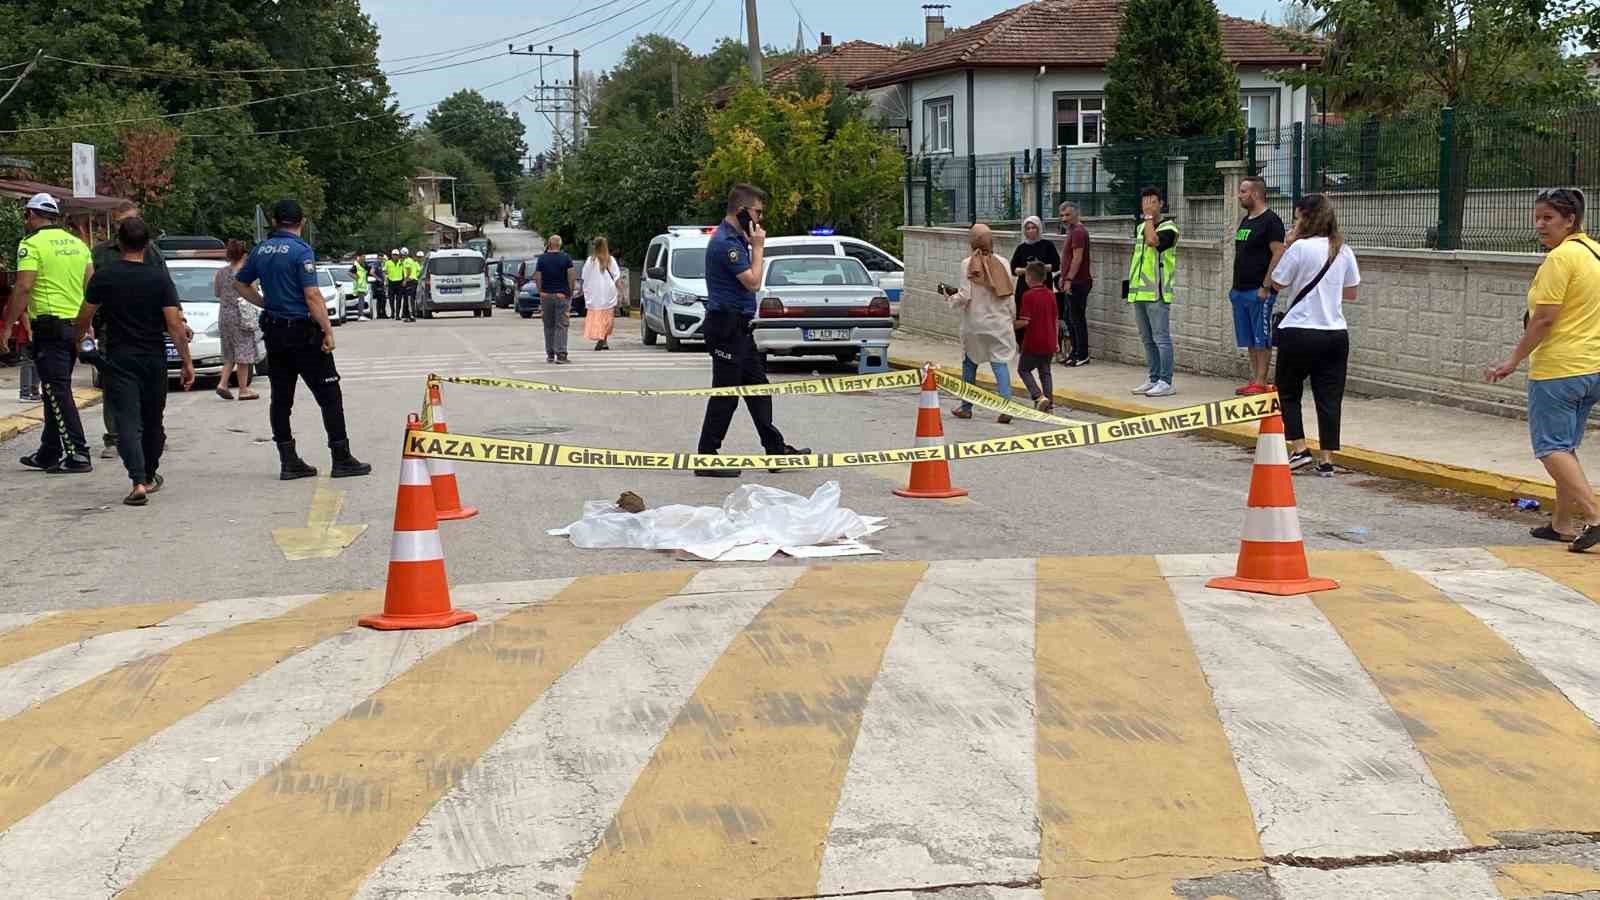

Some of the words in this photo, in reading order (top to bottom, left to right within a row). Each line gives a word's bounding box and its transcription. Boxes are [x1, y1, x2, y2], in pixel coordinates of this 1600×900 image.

[410, 436, 475, 458] KAZA
[480, 443, 533, 462] YERİ
[568, 449, 670, 467] GİRİLMEZ
[693, 456, 754, 468] KAZA
[756, 455, 811, 468] YERİ
[844, 448, 942, 463] GİRİLMEZ
[964, 440, 1025, 456] KAZA
[1026, 429, 1077, 449] YERİ
[1108, 411, 1204, 438] GİRİLMEZ
[1224, 396, 1281, 420] KAZA
